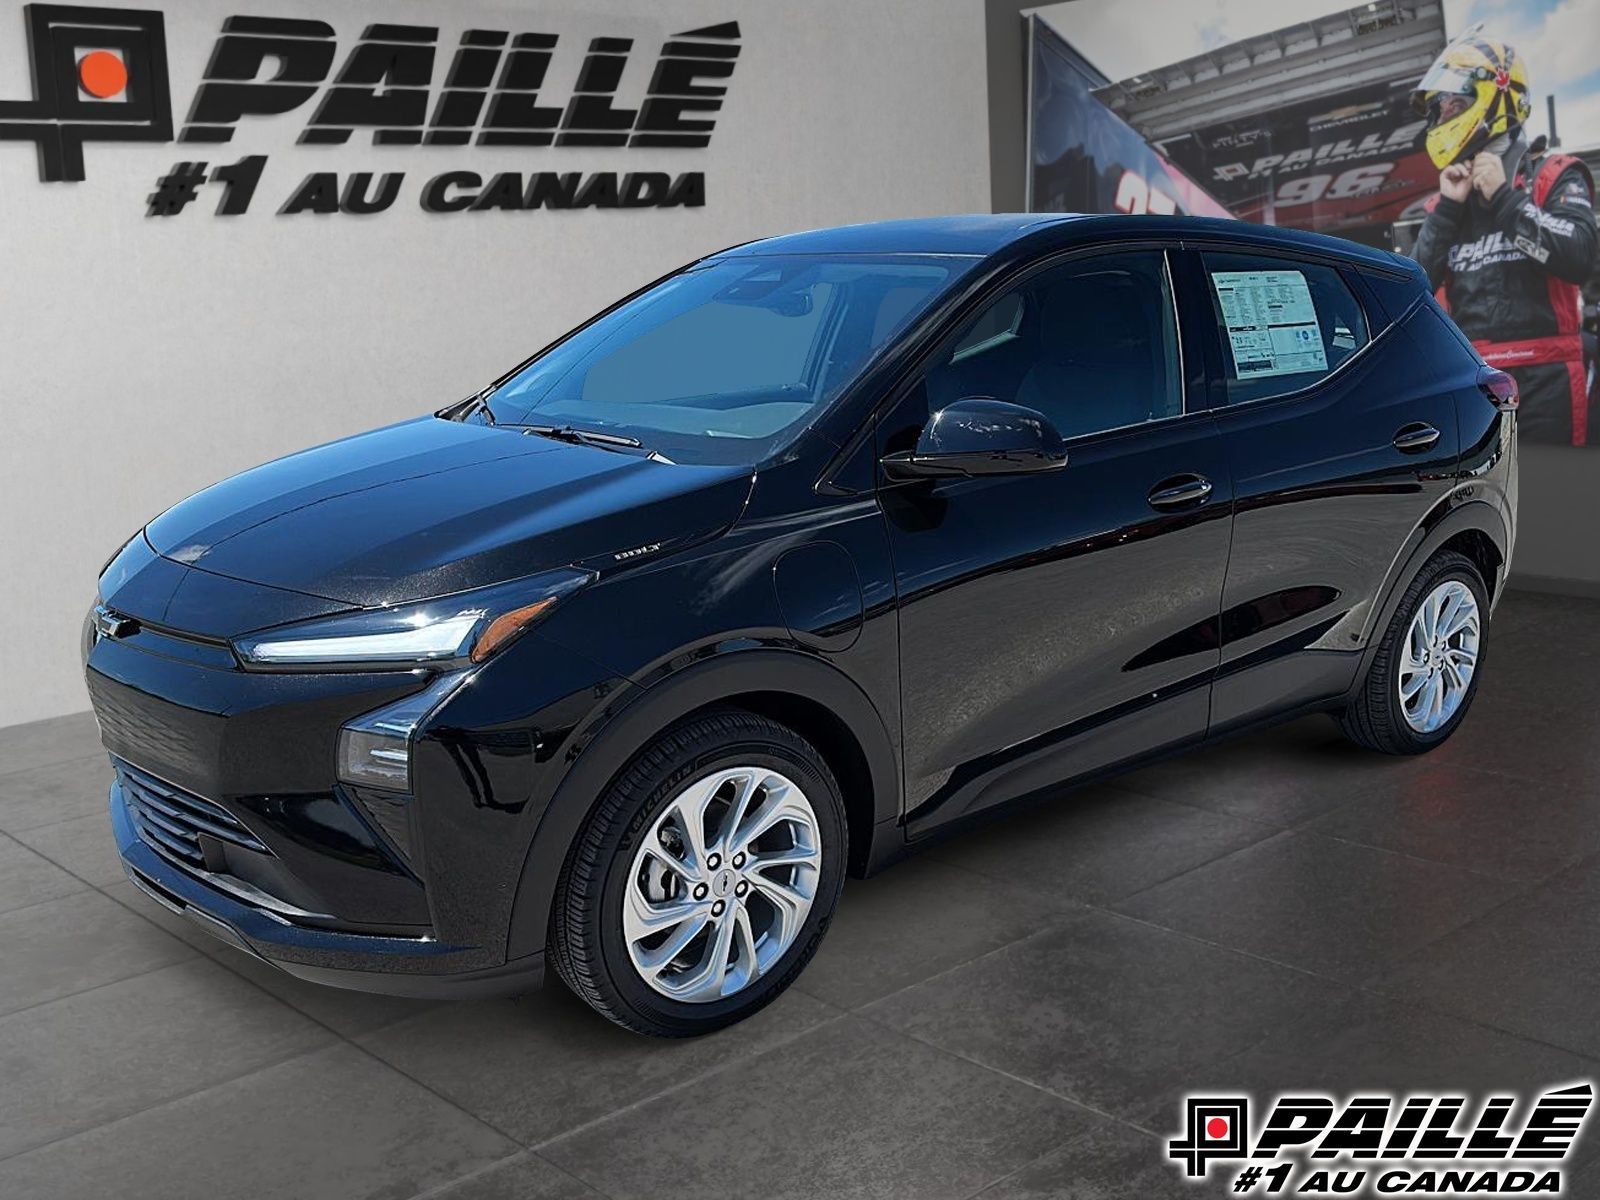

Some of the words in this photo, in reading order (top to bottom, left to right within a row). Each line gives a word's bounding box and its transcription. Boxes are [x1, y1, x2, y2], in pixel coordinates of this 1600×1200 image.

[176, 15, 742, 148] PAILLÉ
[1309, 109, 1389, 132] CHEVROLET
[1316, 141, 1414, 166] CANADA
[145, 155, 268, 217] #1
[276, 172, 405, 216] AU
[419, 171, 706, 213] CANADA
[1275, 162, 1395, 208] 96
